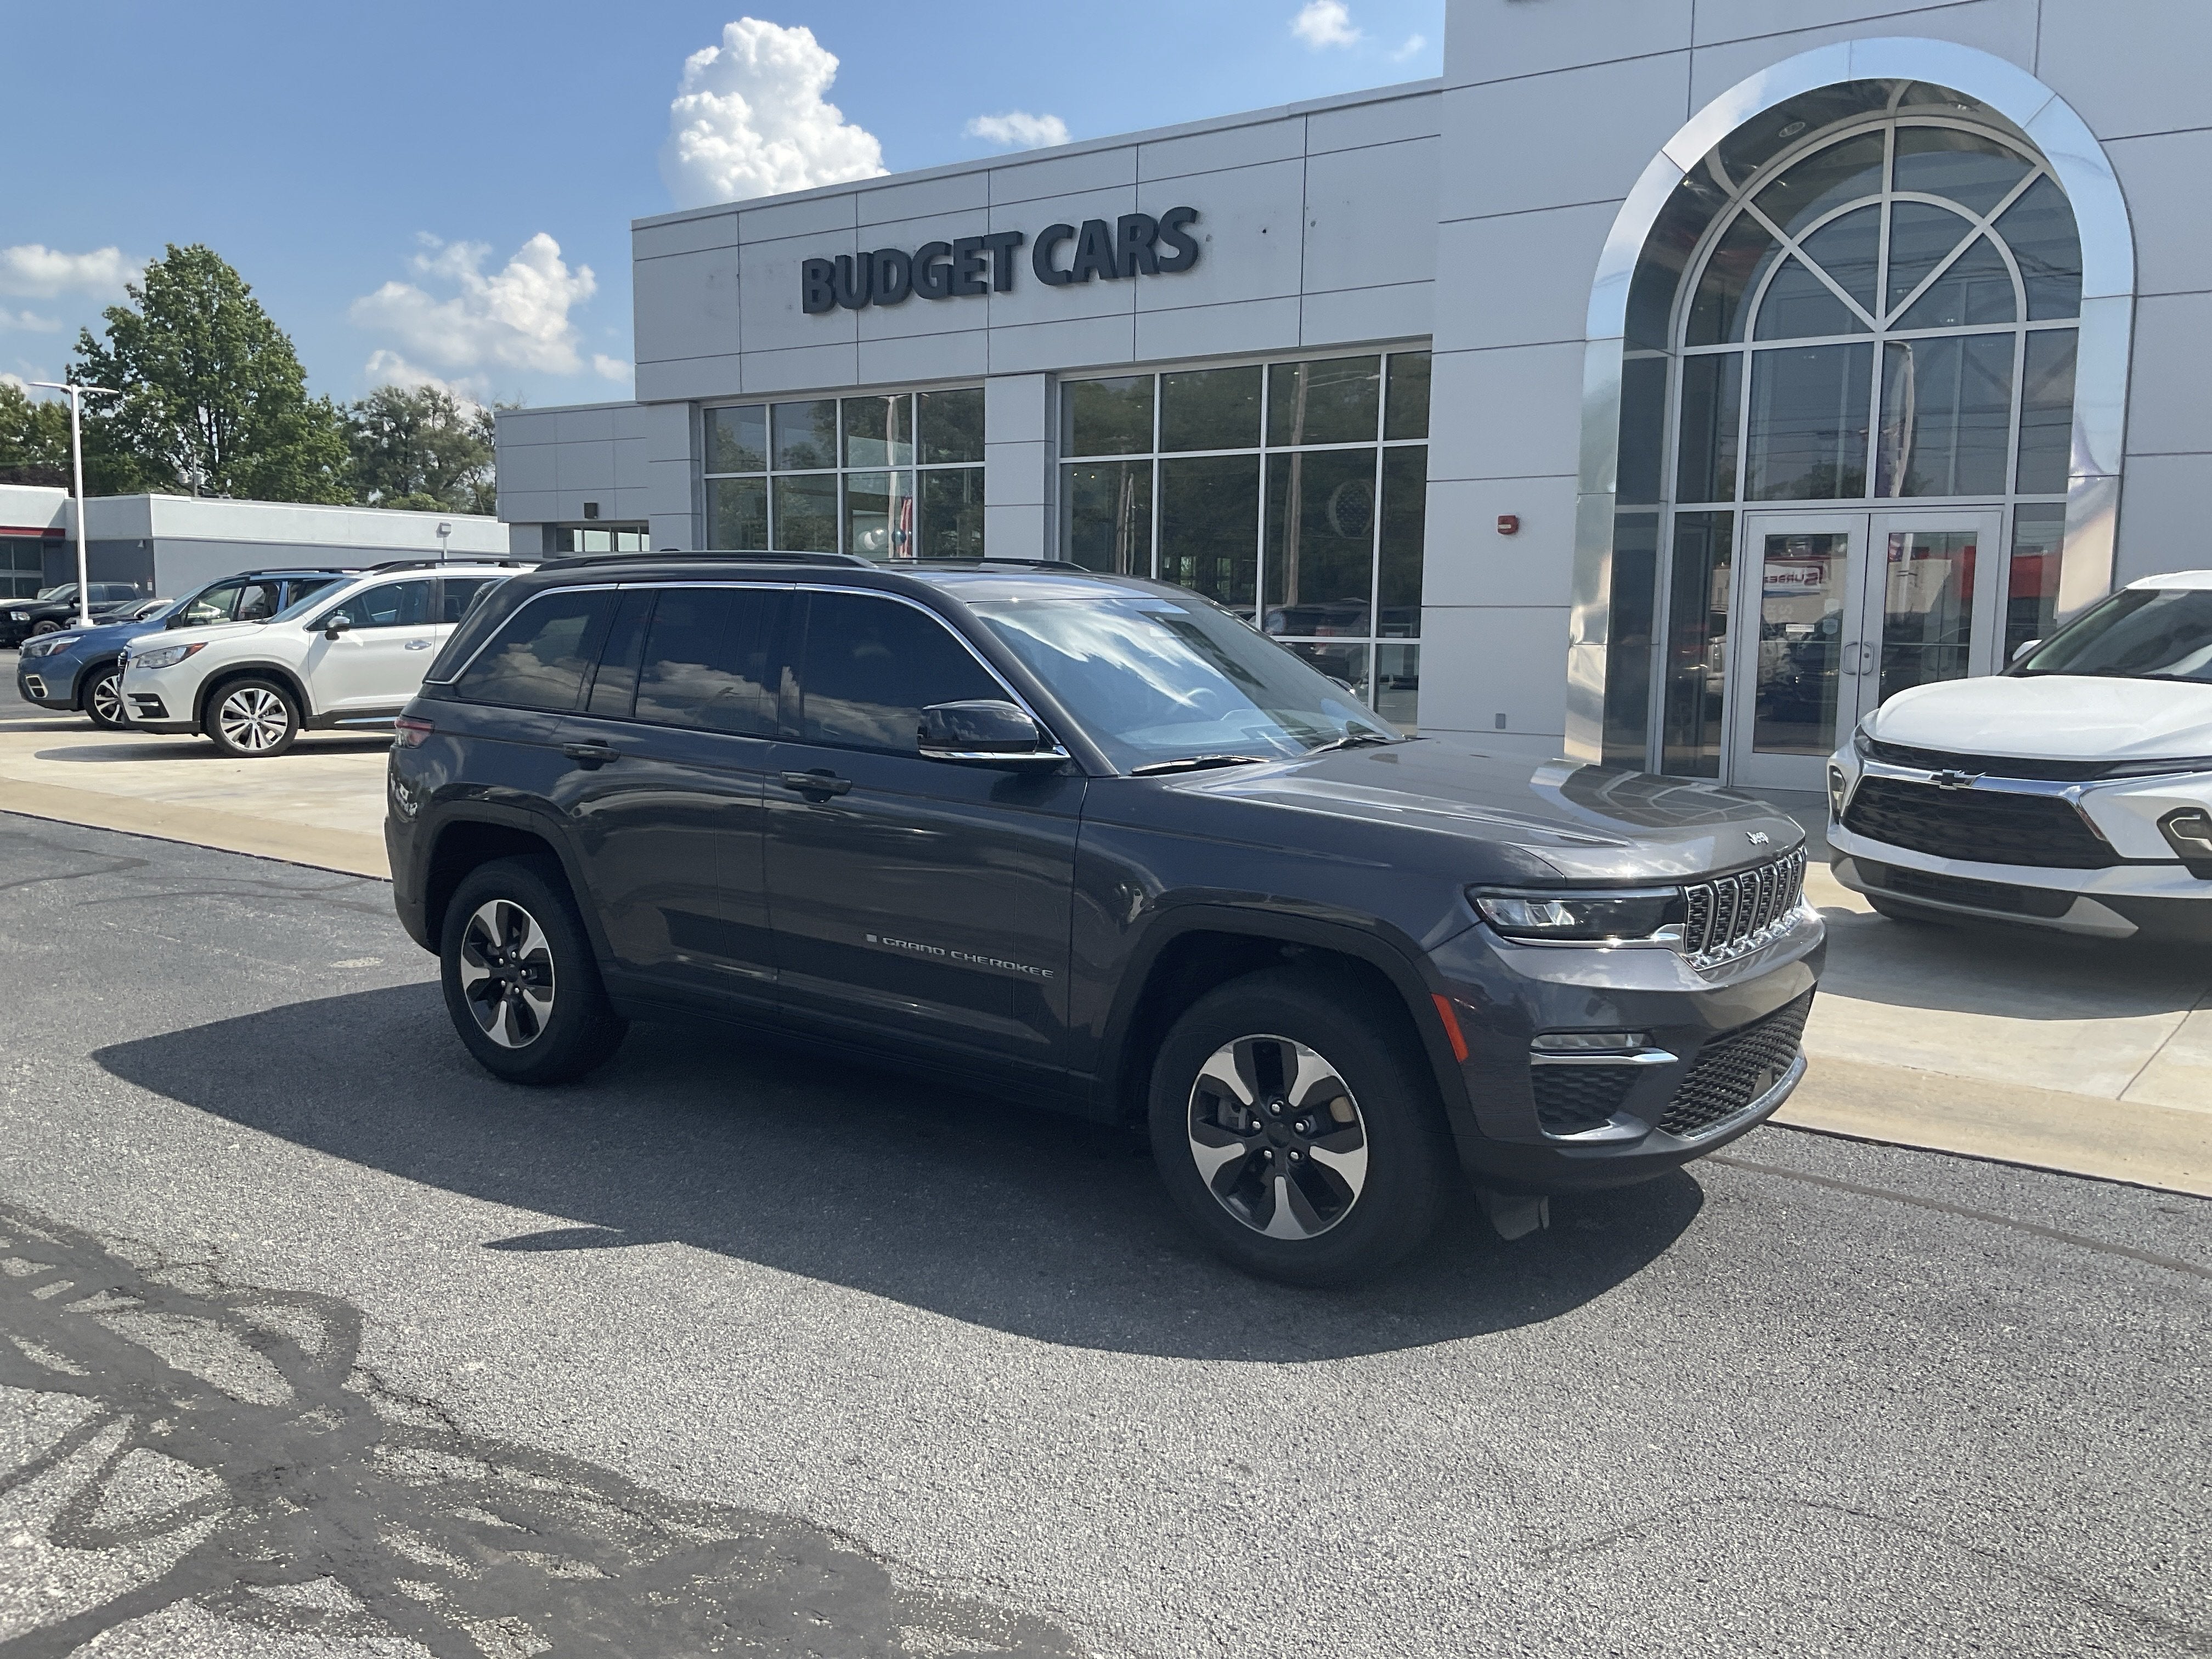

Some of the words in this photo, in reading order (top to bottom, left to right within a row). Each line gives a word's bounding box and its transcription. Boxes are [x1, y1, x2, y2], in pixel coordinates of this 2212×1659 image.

[803, 231, 1024, 314] BUDGET
[1032, 206, 1199, 286] CARS
[1746, 832, 1769, 844] Jeep
[883, 938, 945, 956] GRAND
[951, 951, 1054, 978] CHEROKEE
